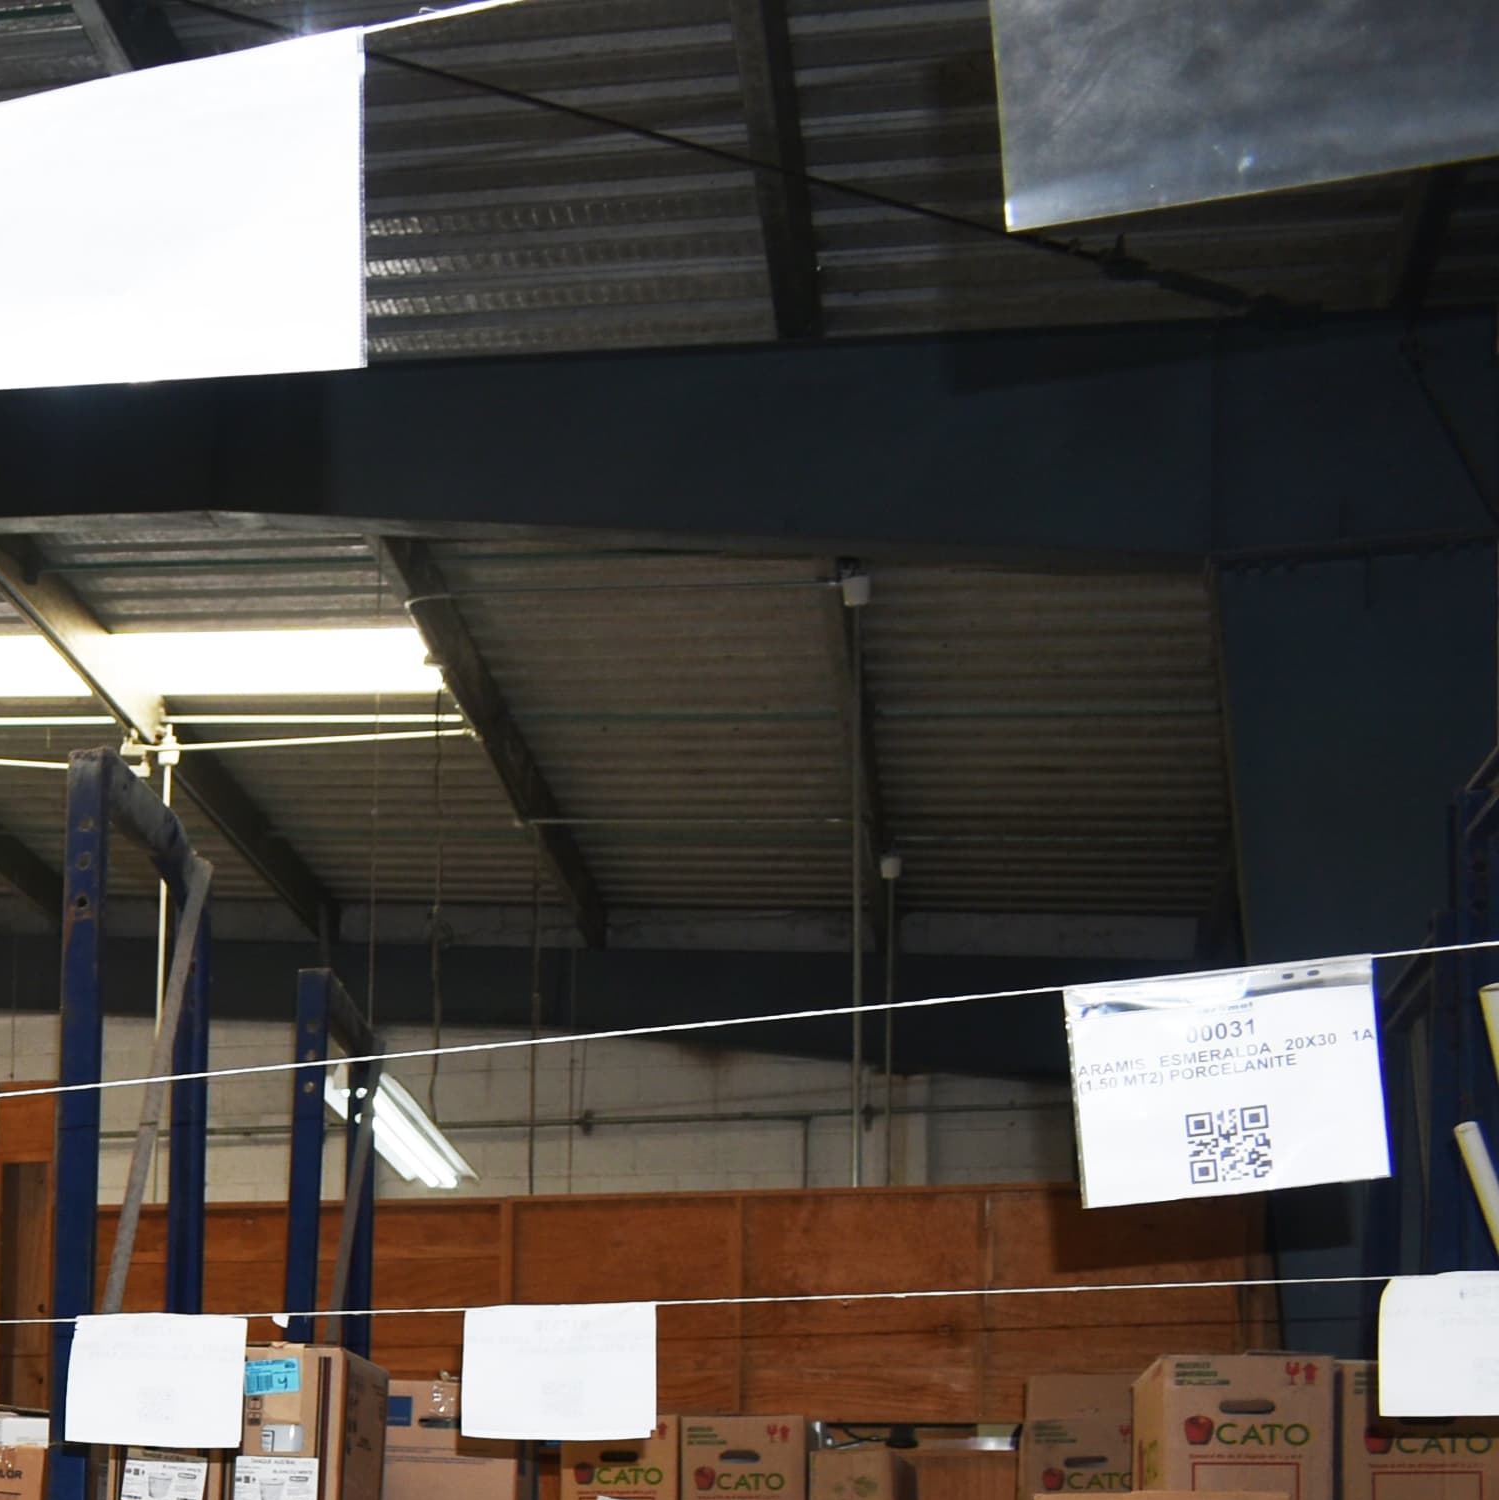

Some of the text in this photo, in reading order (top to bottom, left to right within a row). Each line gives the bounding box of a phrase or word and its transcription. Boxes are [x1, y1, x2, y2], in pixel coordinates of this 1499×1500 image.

[1187, 1019, 1255, 1043] 00031
[1078, 1028, 1375, 1077] ARAMIS ESMERALDA 20X30 1A
[1079, 1053, 1297, 1094] (1.50 MT2) PORCELANITE
[1215, 1423, 1311, 1446] CATO
[1393, 1436, 1493, 1455] CATO
[596, 1466, 664, 1486] CATO
[716, 1472, 786, 1491] CATO
